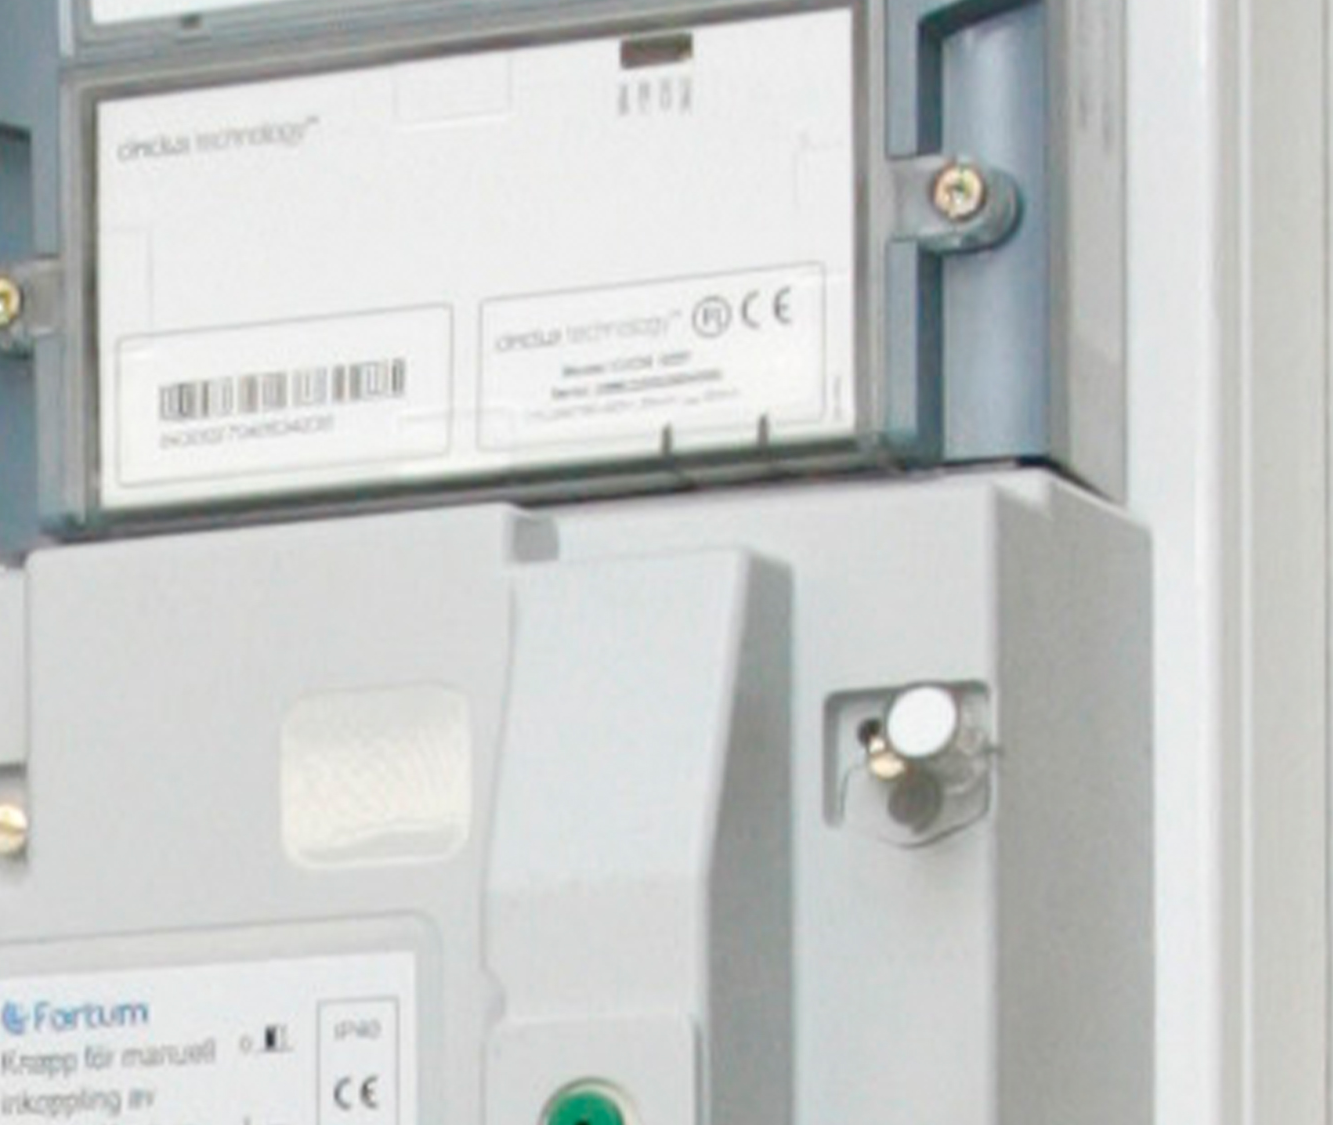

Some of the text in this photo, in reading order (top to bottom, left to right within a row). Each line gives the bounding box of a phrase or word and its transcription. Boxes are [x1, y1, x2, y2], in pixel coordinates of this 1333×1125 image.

[34, 1000, 149, 1031] Fortum
[1, 1049, 78, 1079] Knapp
[121, 1038, 215, 1067] manuell
[334, 1074, 380, 1111] CE
